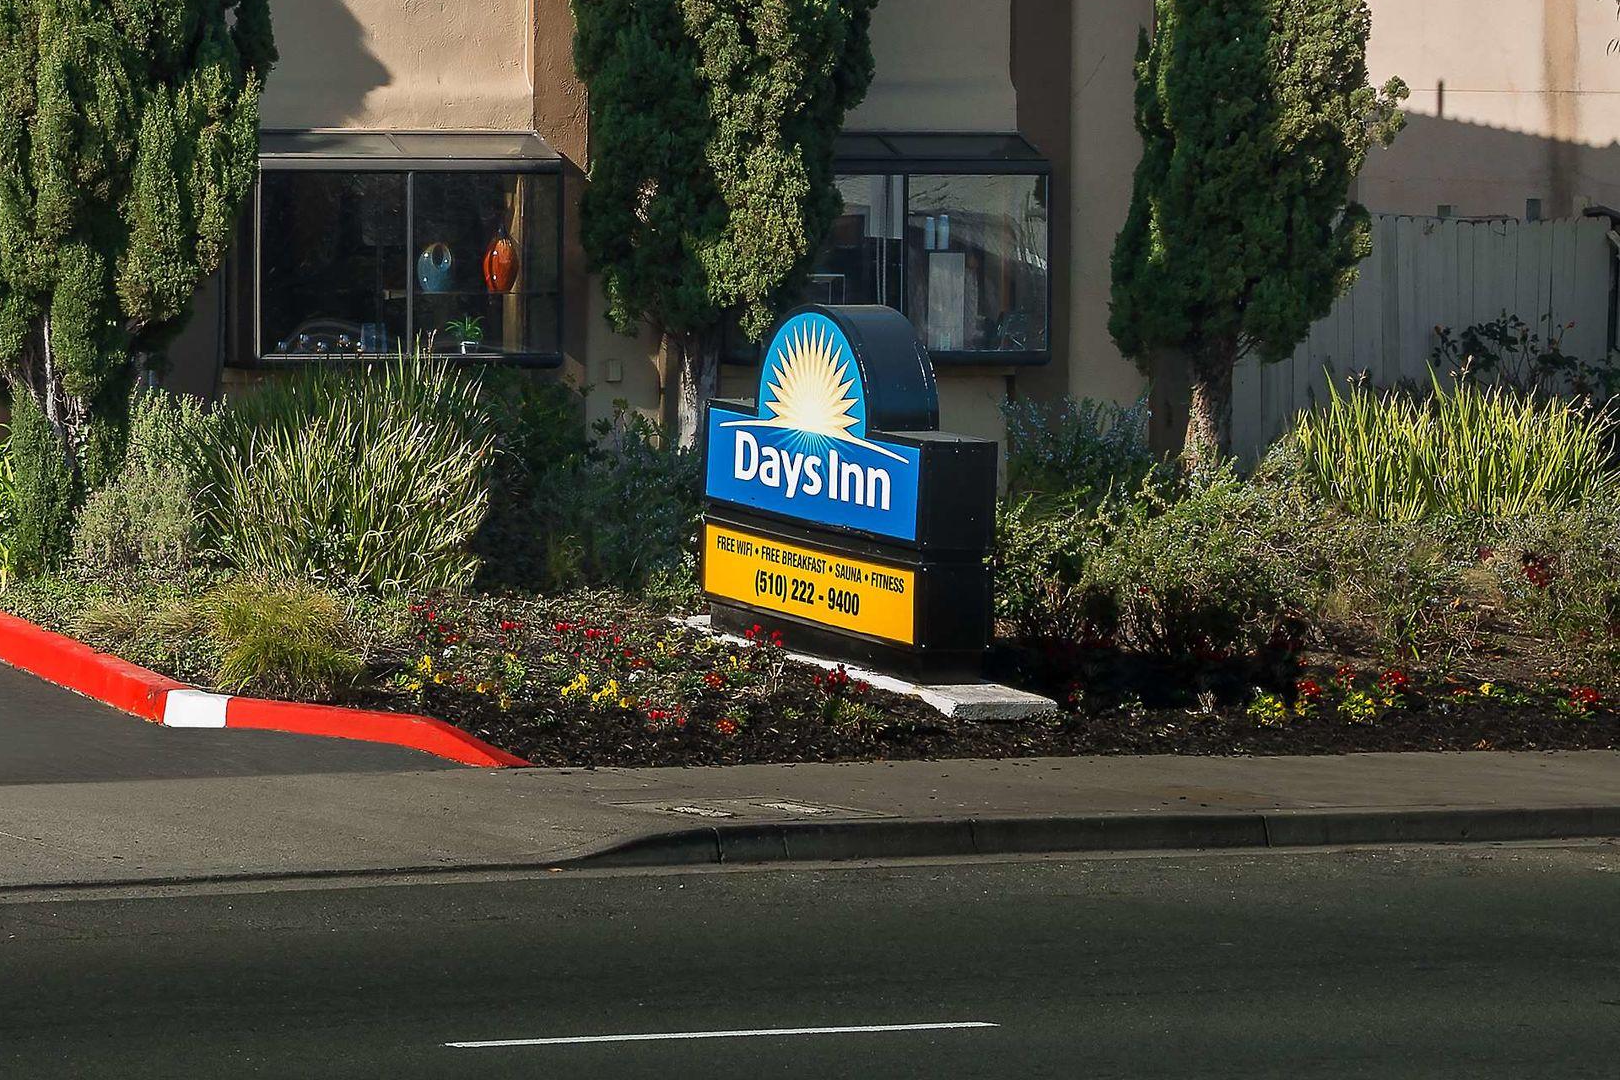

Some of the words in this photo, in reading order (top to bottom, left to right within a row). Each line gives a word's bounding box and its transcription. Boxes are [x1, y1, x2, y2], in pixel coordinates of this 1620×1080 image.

[734, 429, 823, 499] Days
[828, 448, 891, 511] Inn
[716, 535, 736, 553] FREE
[736, 540, 753, 557] WIFI
[761, 546, 780, 564] FREE
[781, 550, 827, 575] BREAKFAST
[834, 562, 862, 584] SAUNA
[870, 571, 905, 594] FITNESS
[754, 569, 788, 603] (510)
[790, 578, 815, 605] 222
[827, 587, 860, 616] 9400
